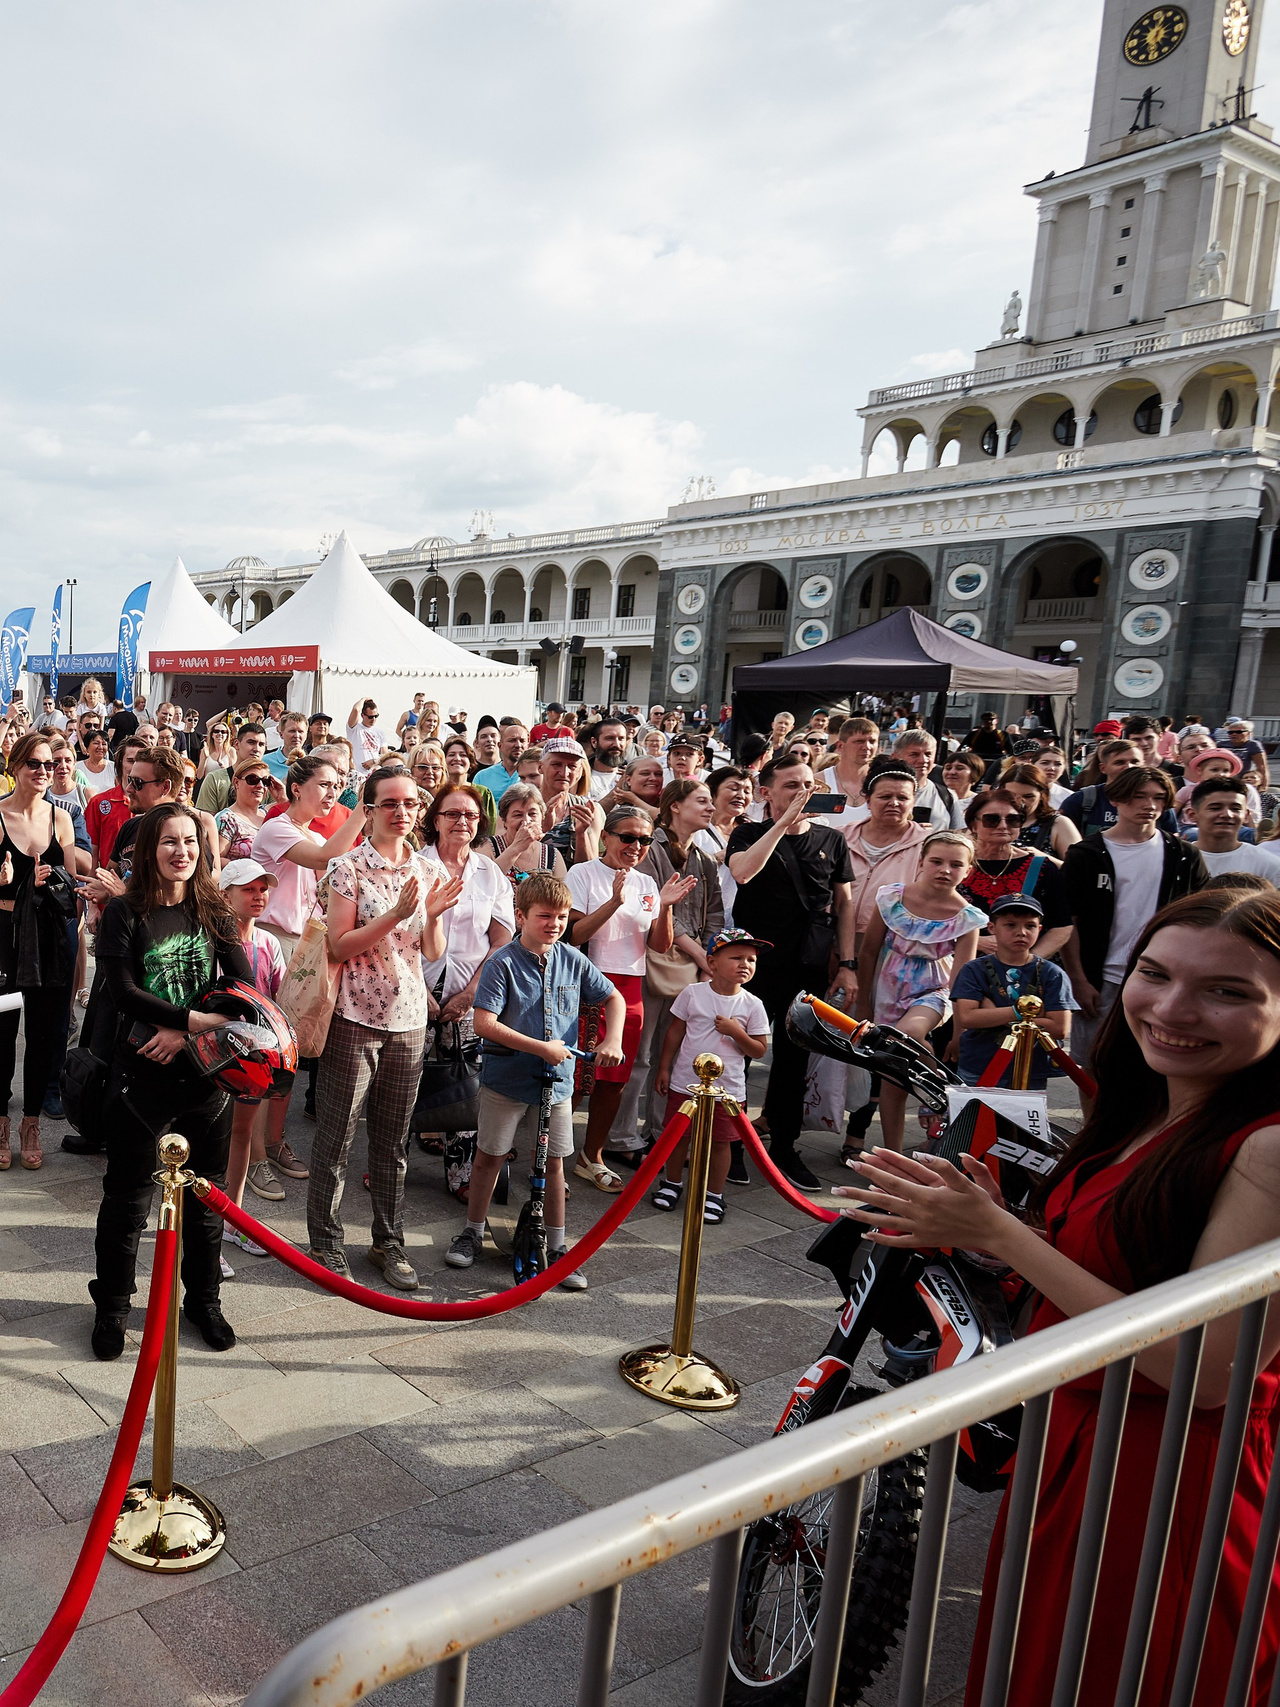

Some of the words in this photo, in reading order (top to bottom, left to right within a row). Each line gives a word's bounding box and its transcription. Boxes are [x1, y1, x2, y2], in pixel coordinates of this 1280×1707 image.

[719, 540, 748, 553] 1933
[777, 529, 867, 547] МОСКВА
[922, 514, 1008, 533] ВОЛГА
[1074, 501, 1125, 519] 1937
[536, 1087, 553, 1170] EXPLORE
